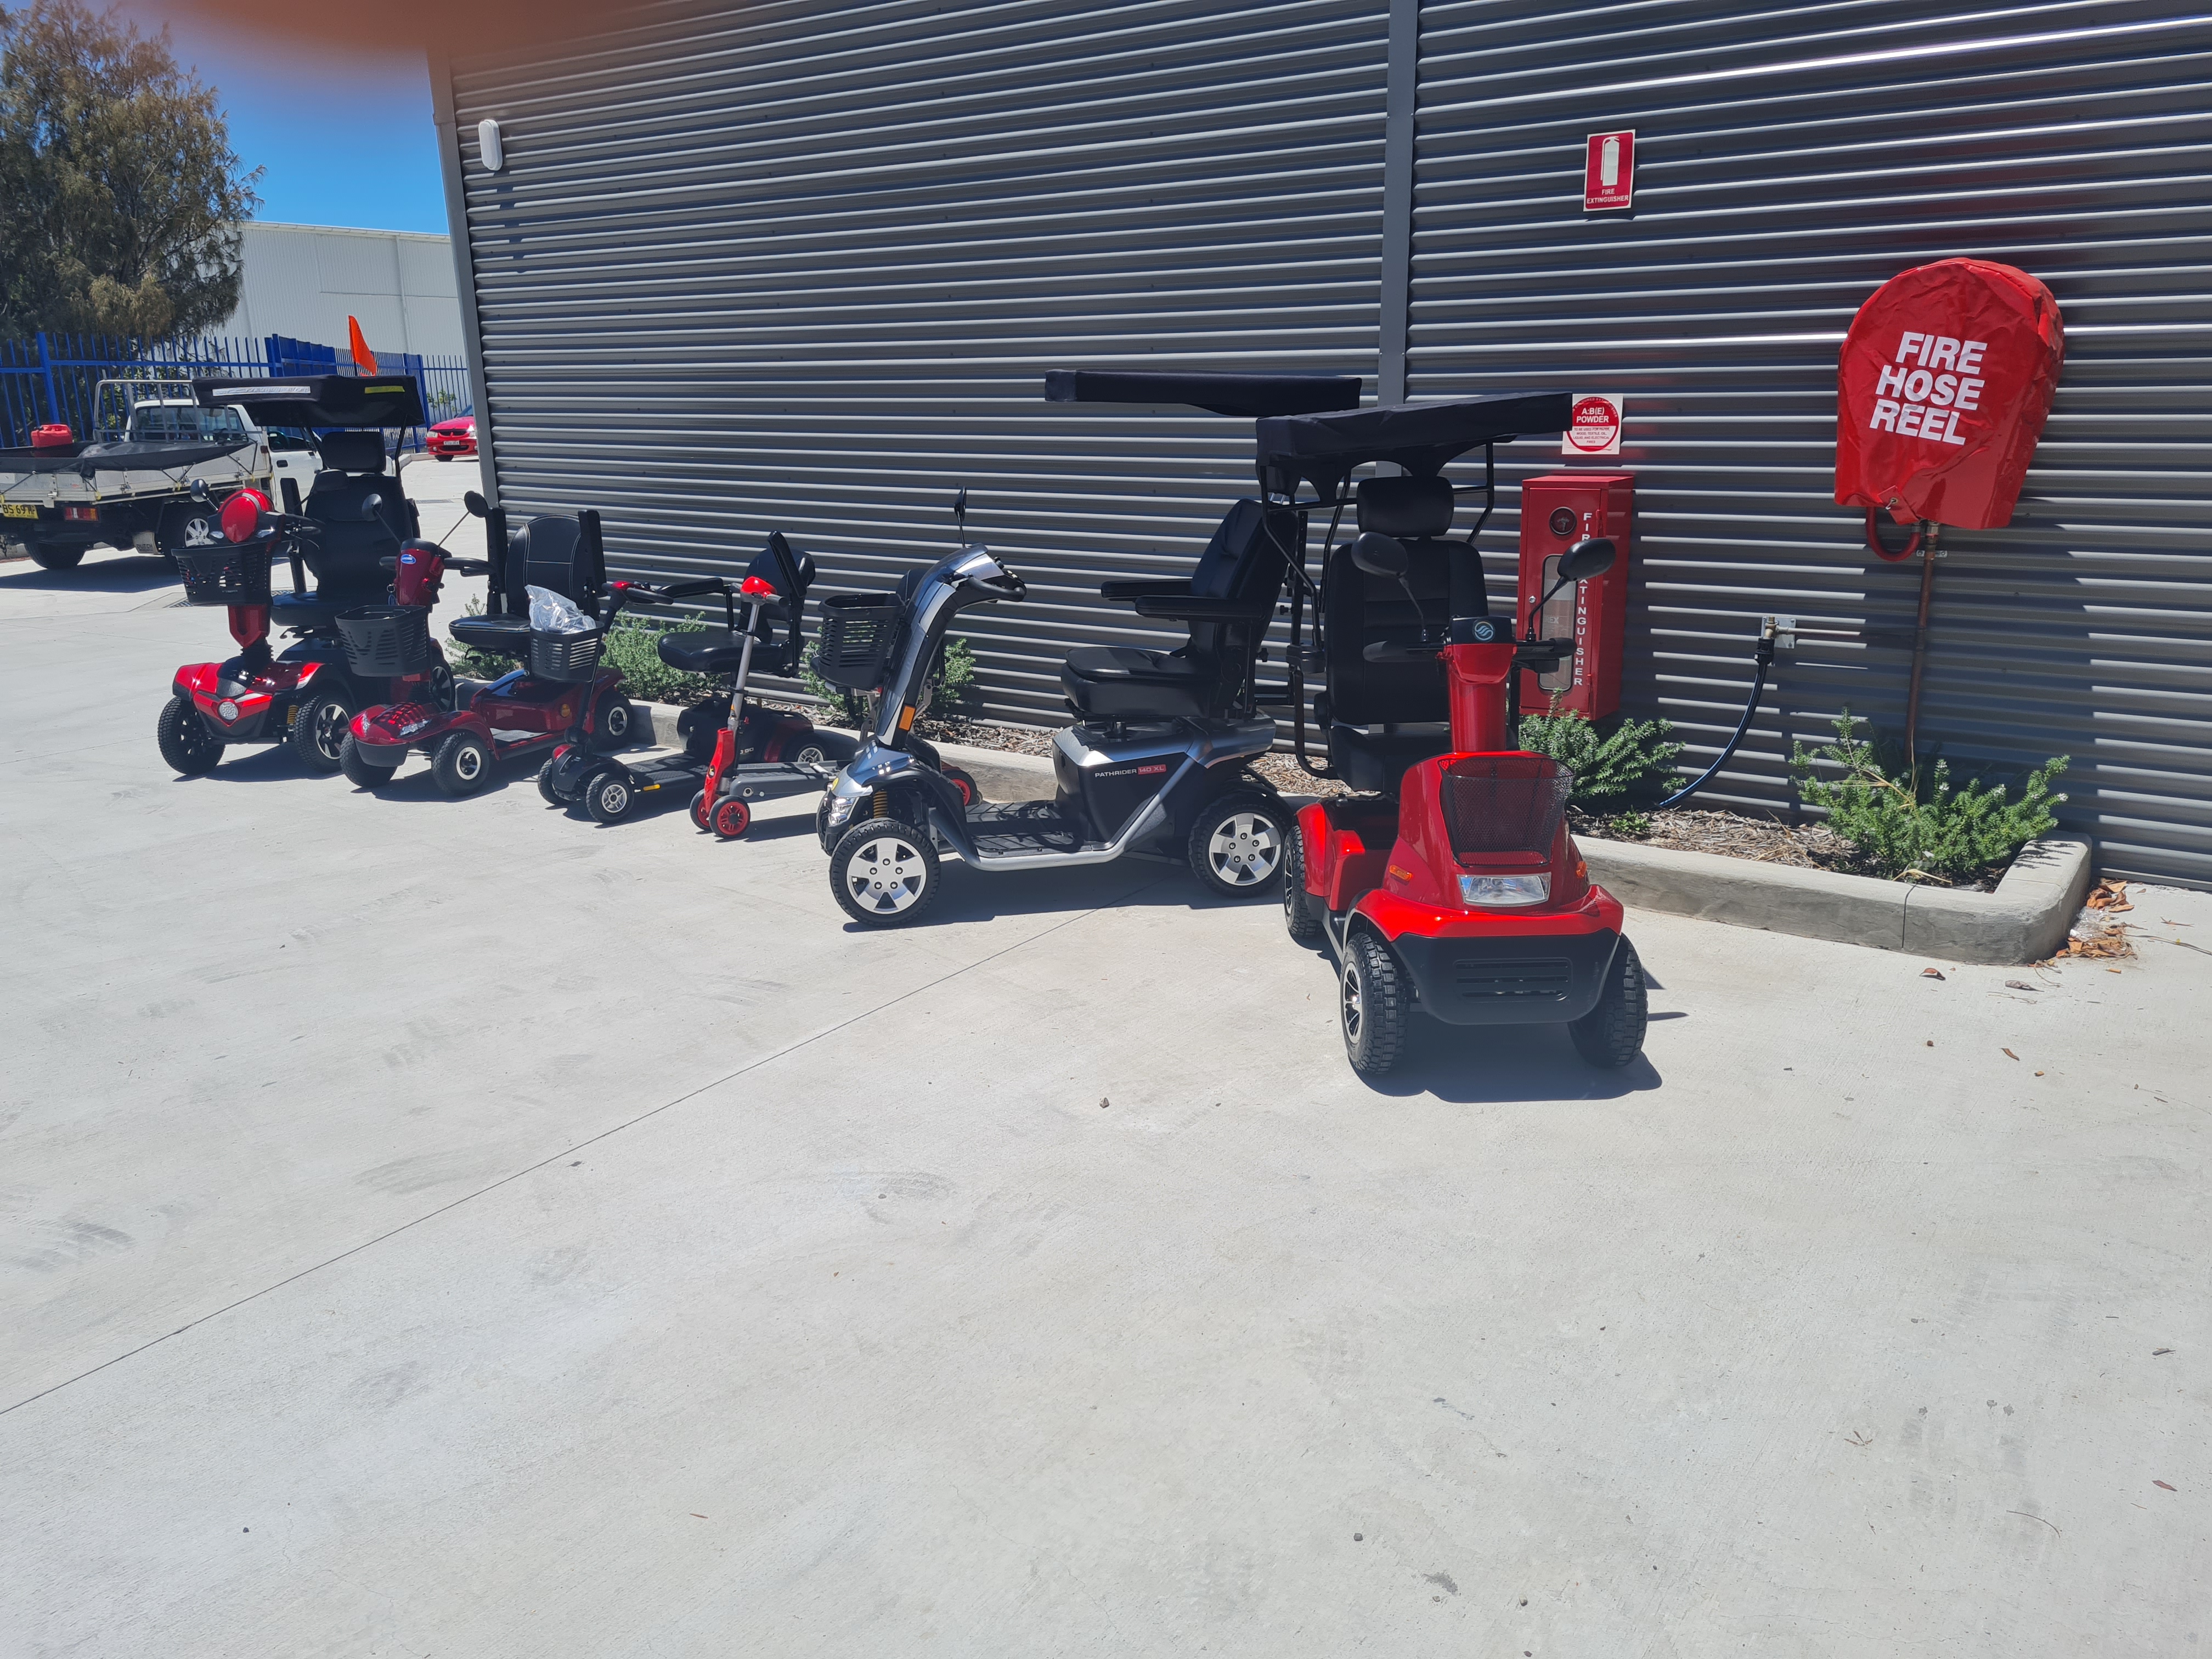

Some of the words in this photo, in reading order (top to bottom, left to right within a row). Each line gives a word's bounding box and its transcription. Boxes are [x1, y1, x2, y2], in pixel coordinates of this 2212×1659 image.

[1587, 195, 1629, 204] EXTINGUISHER
[1895, 331, 1988, 375] FIRE
[1875, 364, 1985, 410] HOSE
[1582, 407, 1604, 415] A:B(E)
[1869, 398, 1966, 445] REEL
[1582, 512, 1593, 541] FIR
[1574, 579, 1588, 686] XTINGUISHER
[1094, 769, 1137, 777] PATHRIDER
